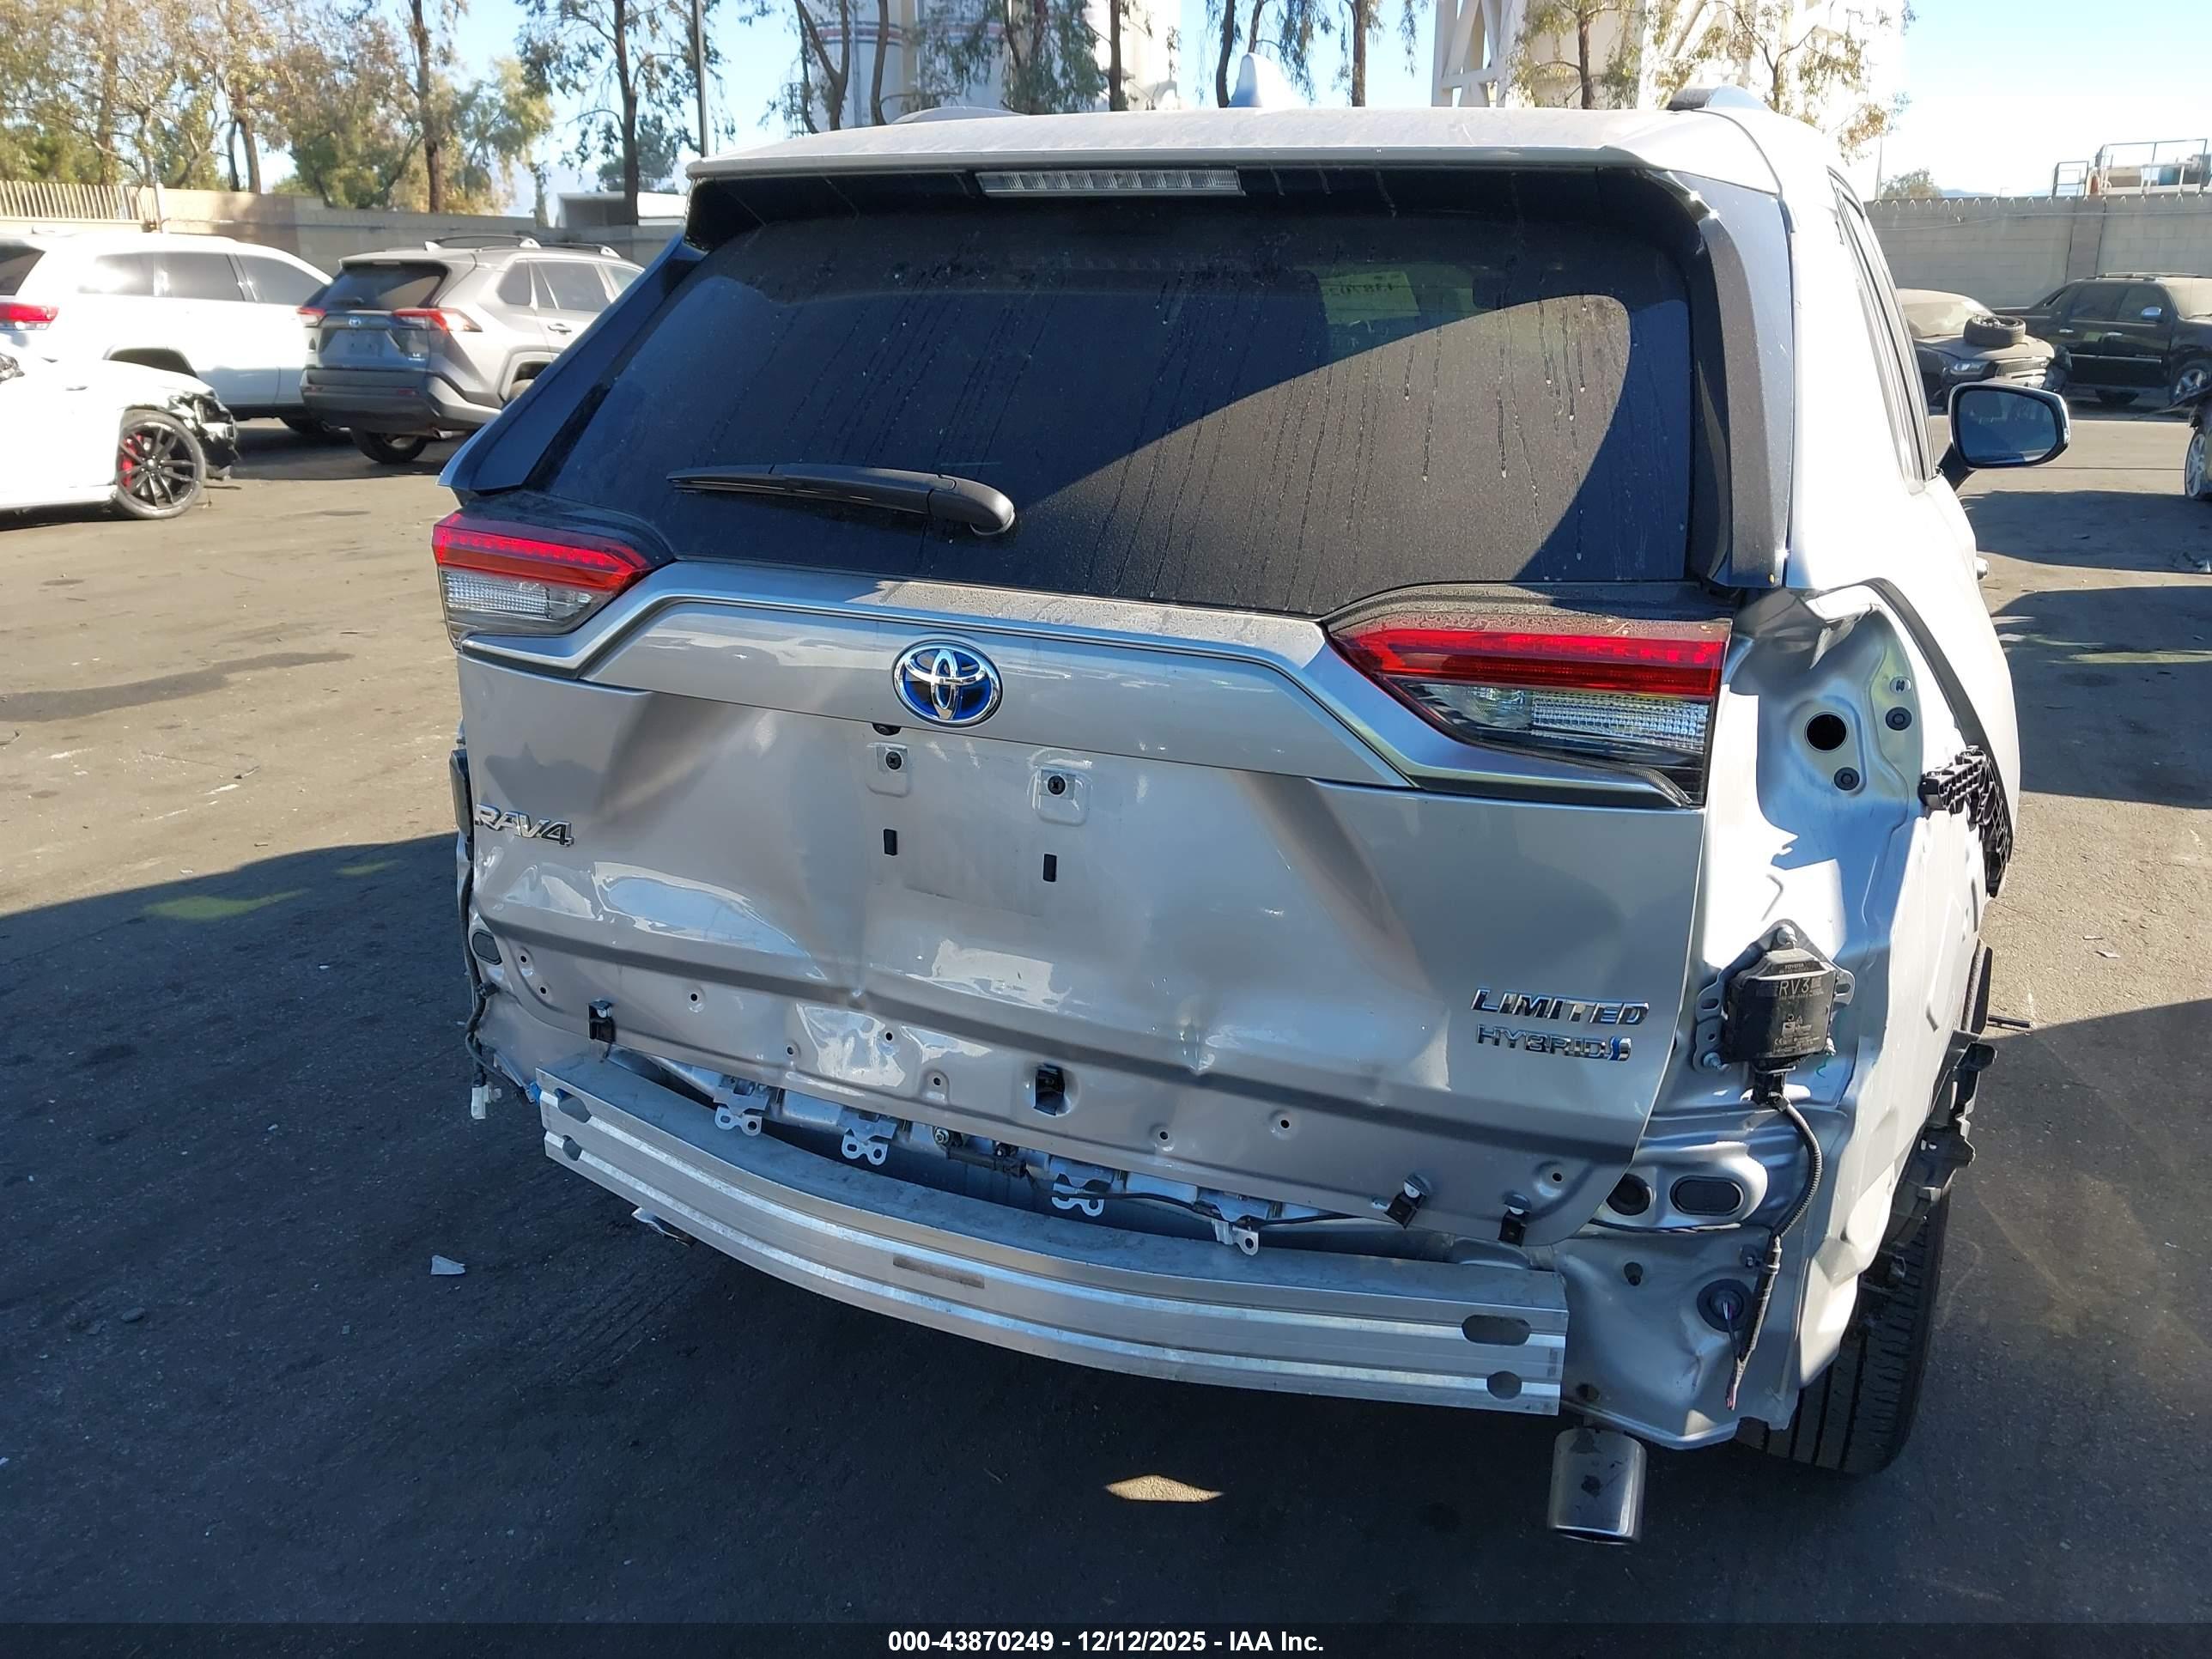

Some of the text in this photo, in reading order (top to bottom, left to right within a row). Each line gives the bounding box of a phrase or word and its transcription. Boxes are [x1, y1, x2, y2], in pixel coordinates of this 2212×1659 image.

[475, 804, 574, 847] RAV4
[1779, 977, 1810, 996] RV3
[1471, 988, 1650, 1024] LIMITED
[1477, 1024, 1608, 1059] HYBRID
